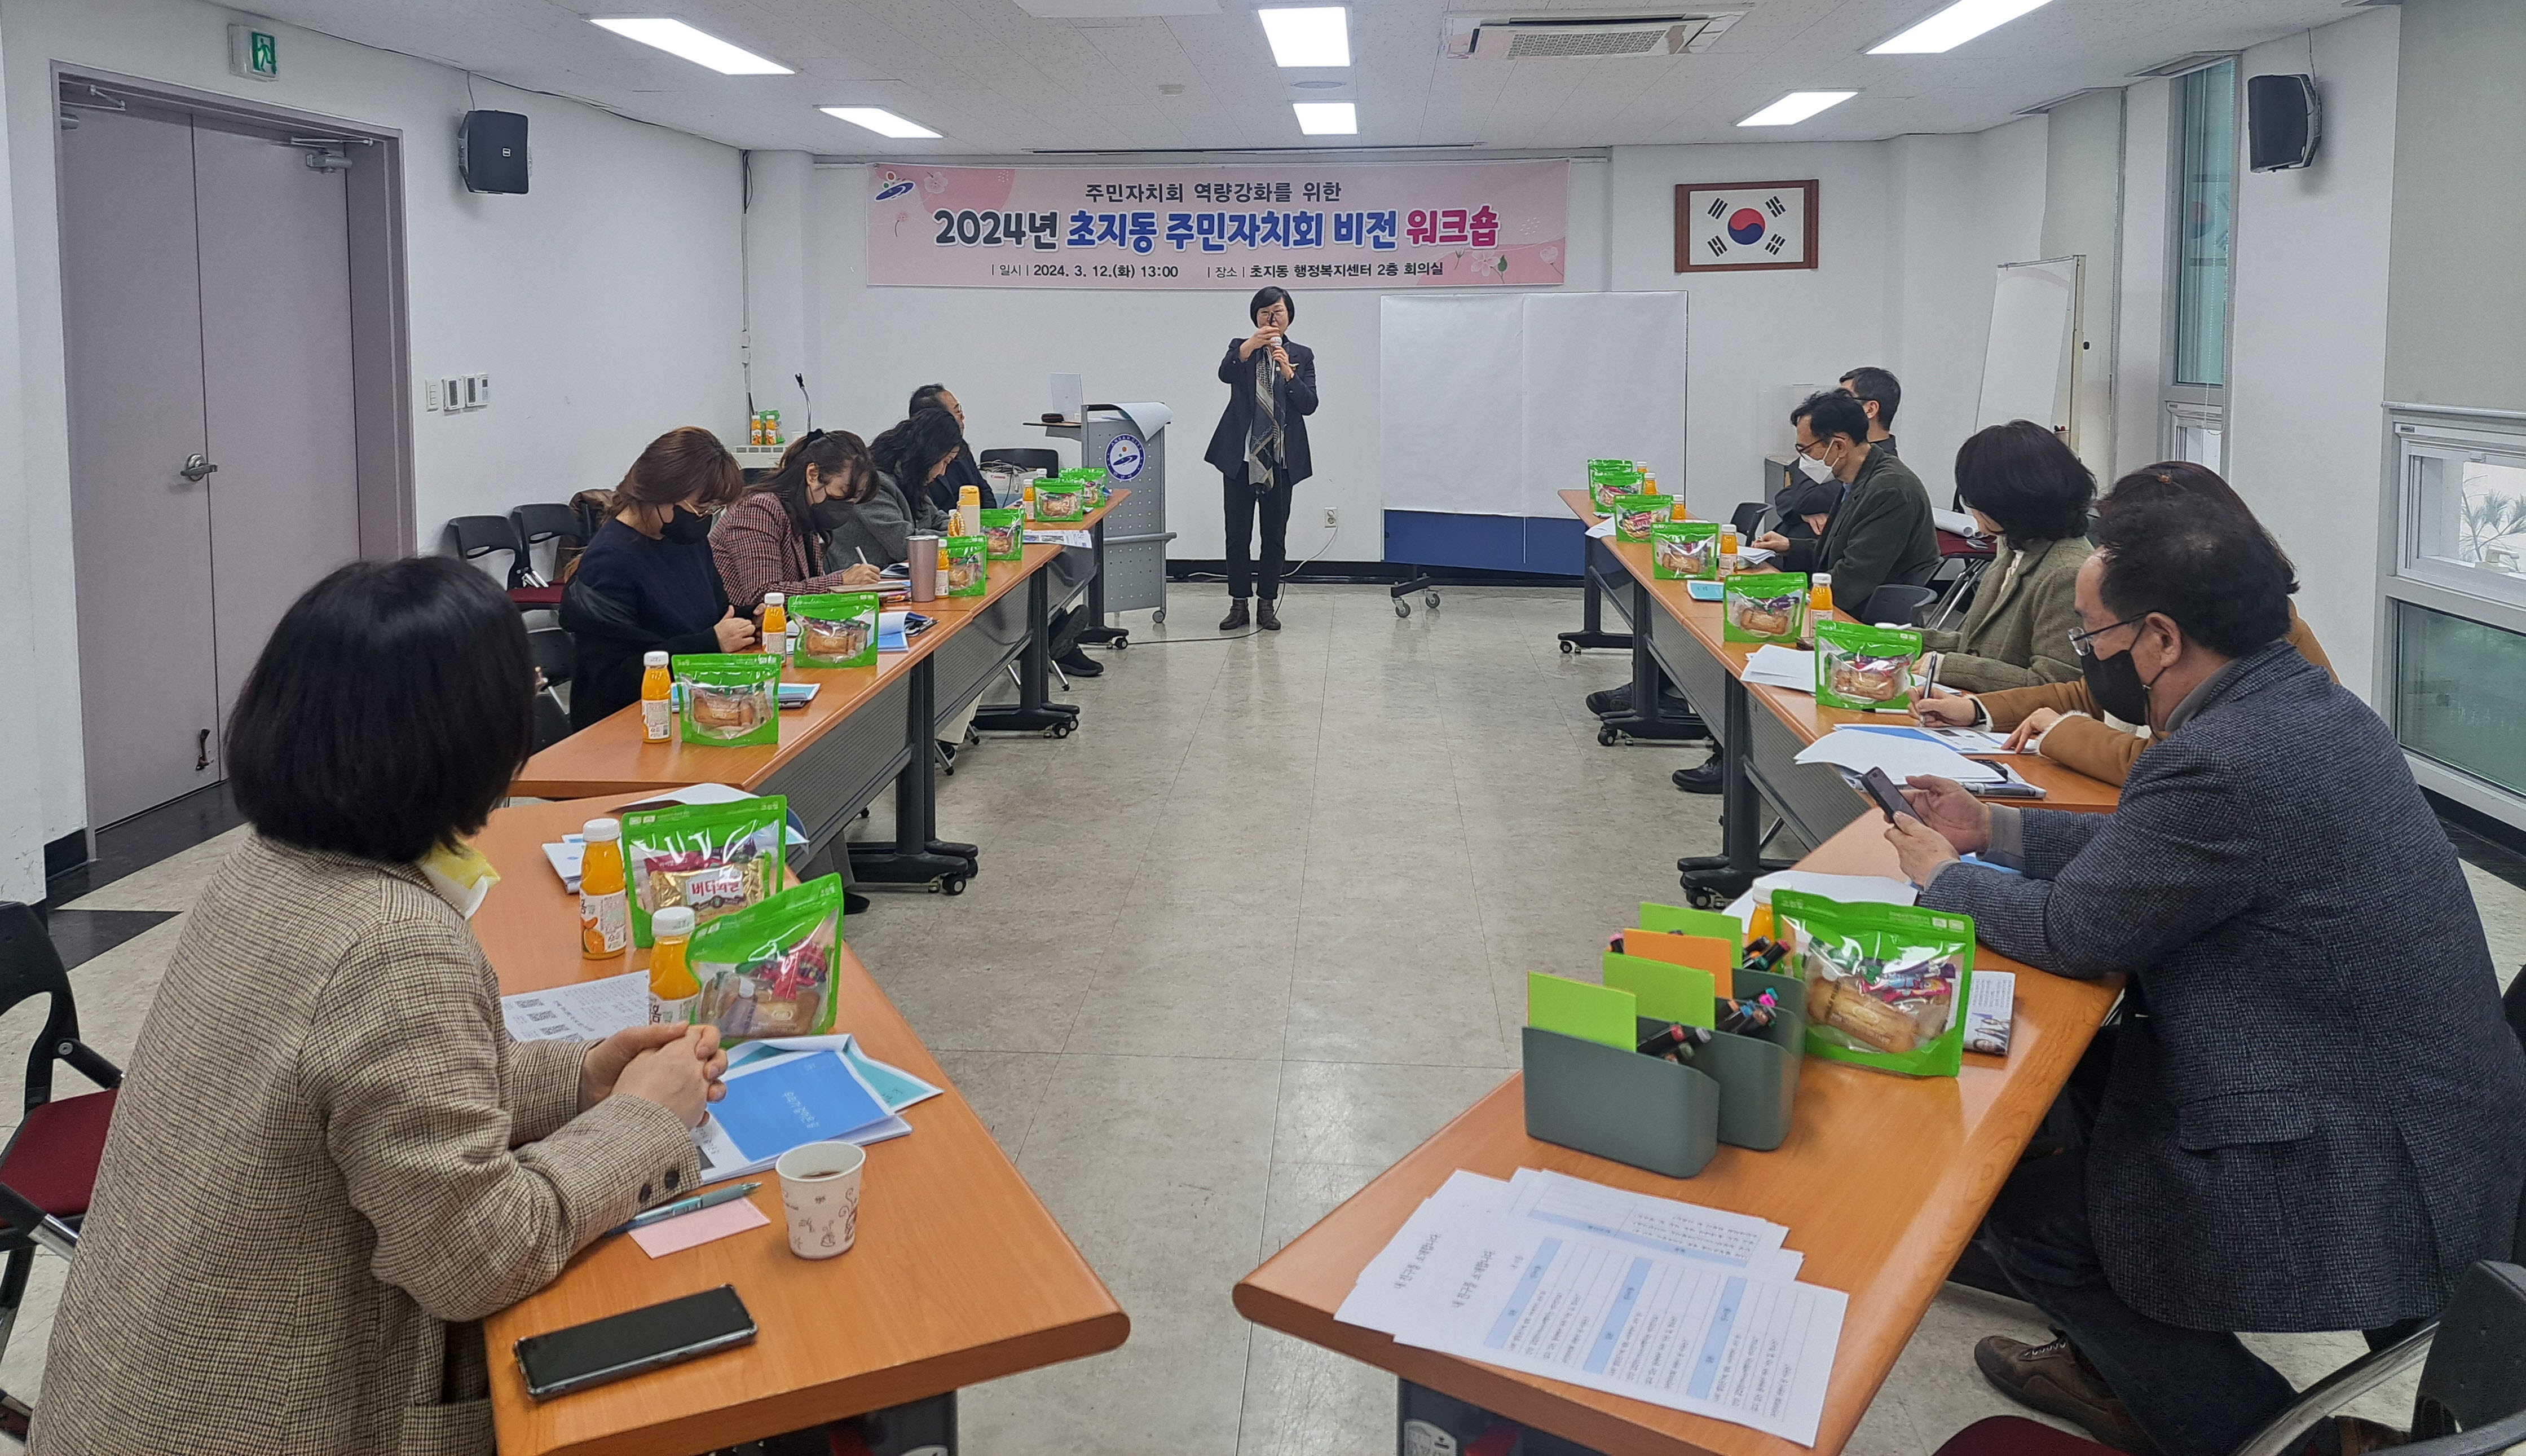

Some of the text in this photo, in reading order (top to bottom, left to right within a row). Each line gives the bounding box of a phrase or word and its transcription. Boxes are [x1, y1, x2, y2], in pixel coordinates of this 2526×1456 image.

[1085, 182, 1342, 203] 주민자치회 역량강화를 위한
[933, 205, 1499, 253] 2024년 초지동 주민자치회 비전 워크숍
[999, 264, 1179, 279] 일시 2024. 3. 12.(화) 13:00
[1215, 262, 1443, 279] 장소 초지동 행정복지센터 2층 회의실
